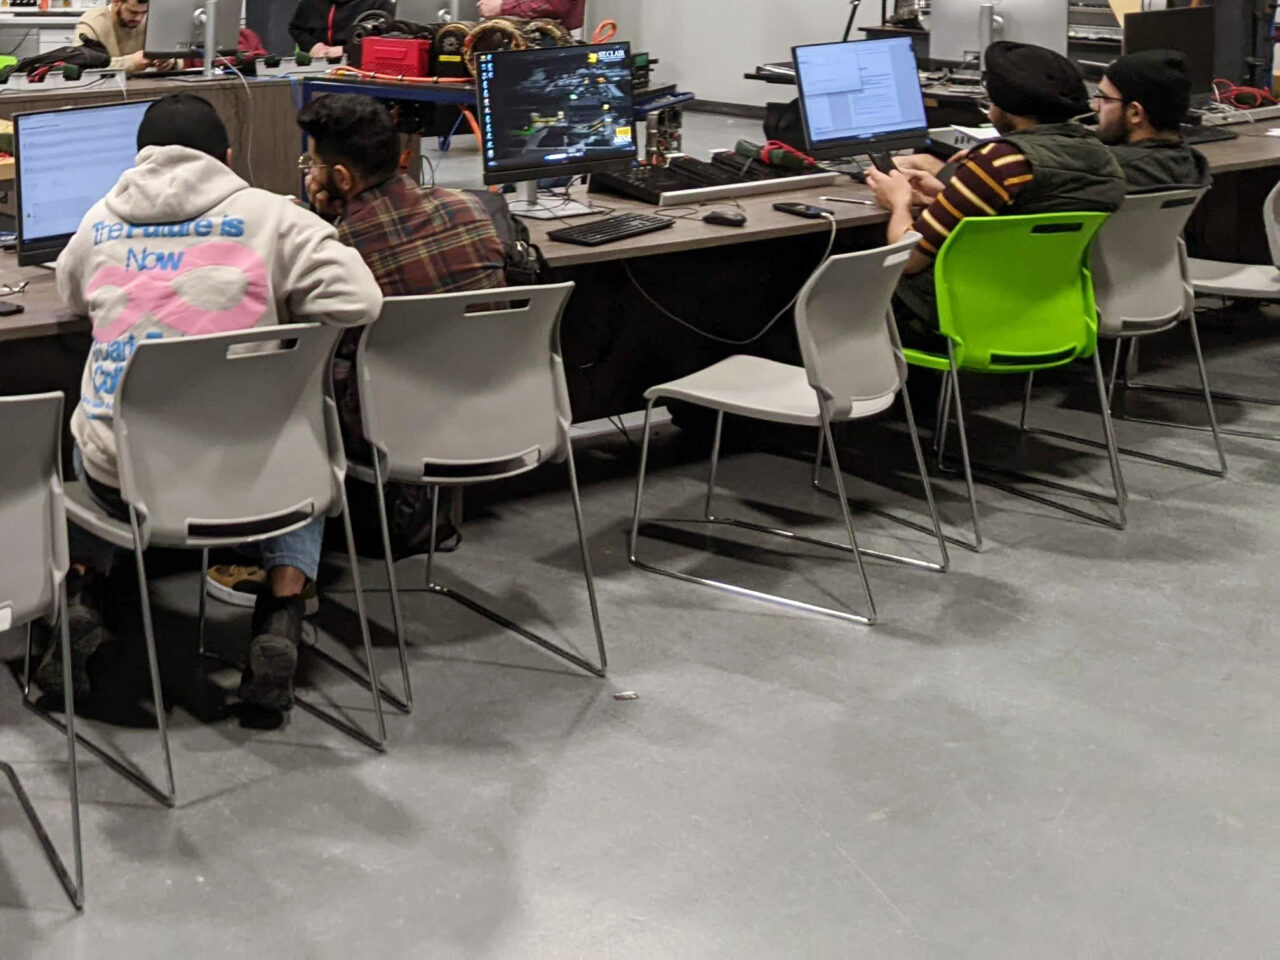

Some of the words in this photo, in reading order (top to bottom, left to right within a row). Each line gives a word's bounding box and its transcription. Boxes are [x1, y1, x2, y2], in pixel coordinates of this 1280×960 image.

[93, 220, 123, 245] The
[220, 214, 245, 238] is
[126, 246, 185, 273] Now
